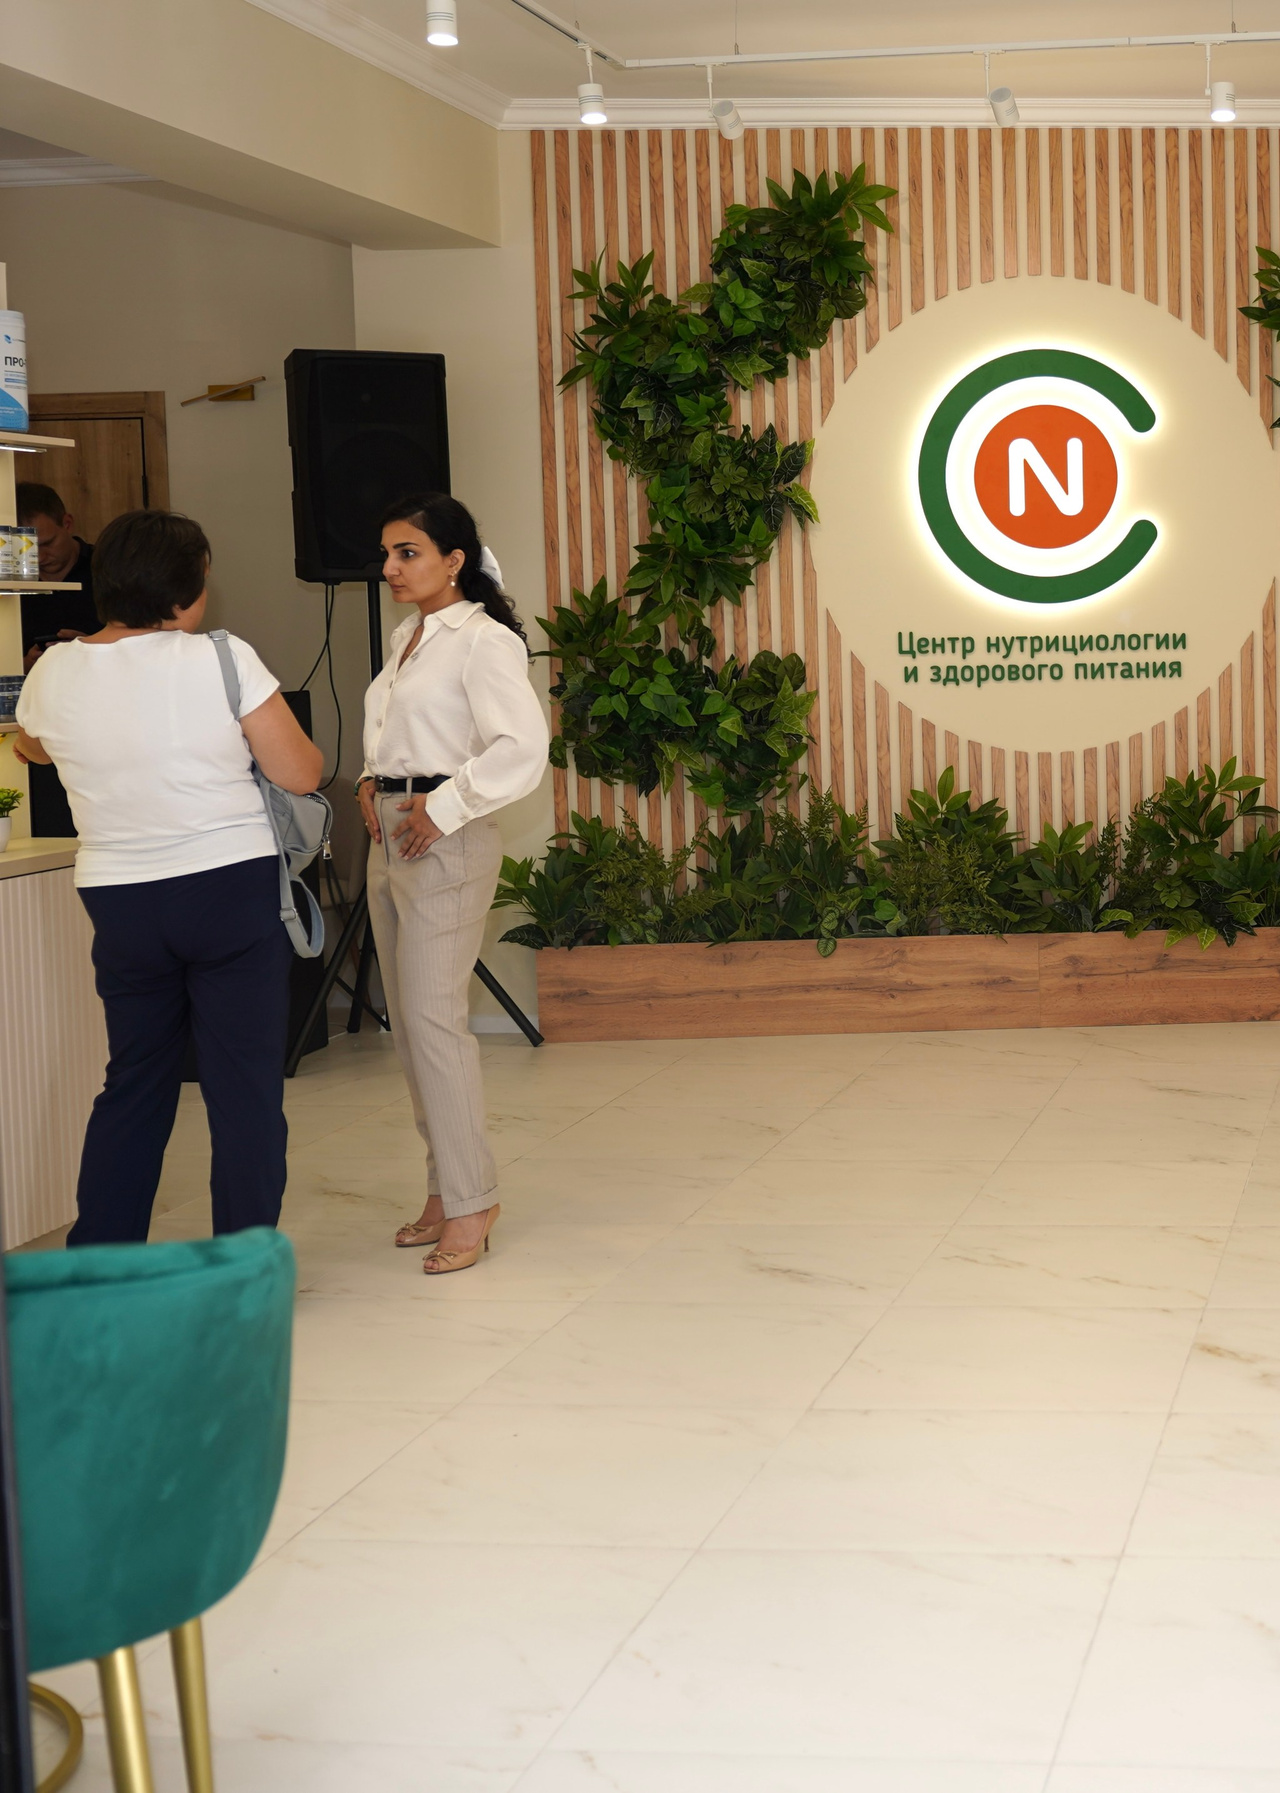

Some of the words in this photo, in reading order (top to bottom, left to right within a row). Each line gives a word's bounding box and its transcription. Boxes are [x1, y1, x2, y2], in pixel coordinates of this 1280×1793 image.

[1008, 437, 1084, 517] N
[897, 631, 976, 660] Центр
[986, 632, 1187, 659] нутрициологии
[903, 665, 919, 683] и
[929, 663, 1064, 688] здорового
[1074, 661, 1182, 680] питания
